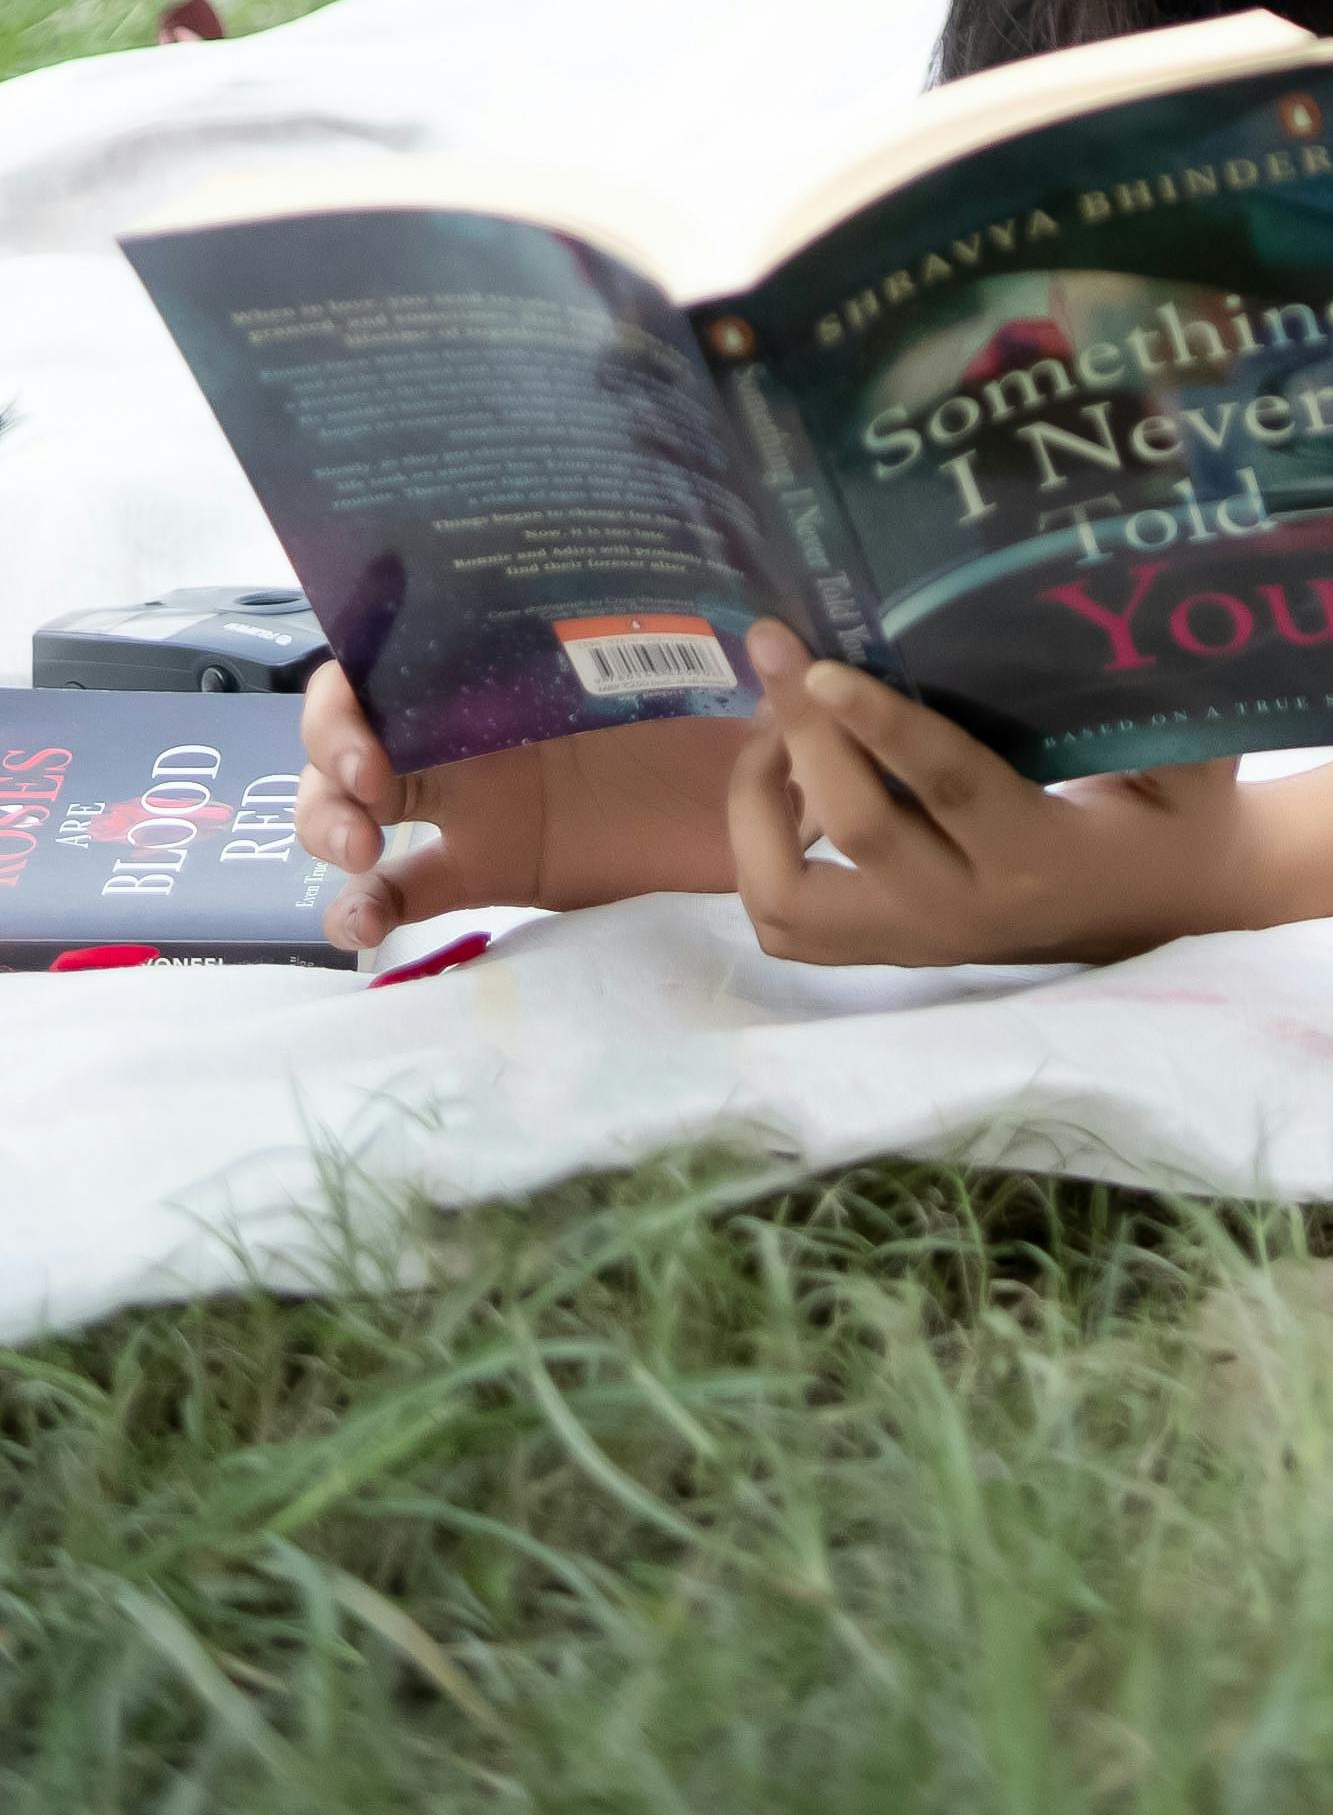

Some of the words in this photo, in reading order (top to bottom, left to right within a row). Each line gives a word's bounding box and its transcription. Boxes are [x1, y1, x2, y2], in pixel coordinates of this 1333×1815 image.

[815, 208, 1060, 348] SHRAVYA
[939, 448, 998, 526] I
[1038, 465, 1279, 567] Told
[1151, 708, 1188, 726] ON
[1207, 704, 1221, 719] A
[1234, 695, 1310, 716] TRUE
[55, 801, 106, 849] ARE
[101, 744, 223, 897] BLOOD
[219, 774, 301, 862] RED
[295, 885, 320, 907] Even
